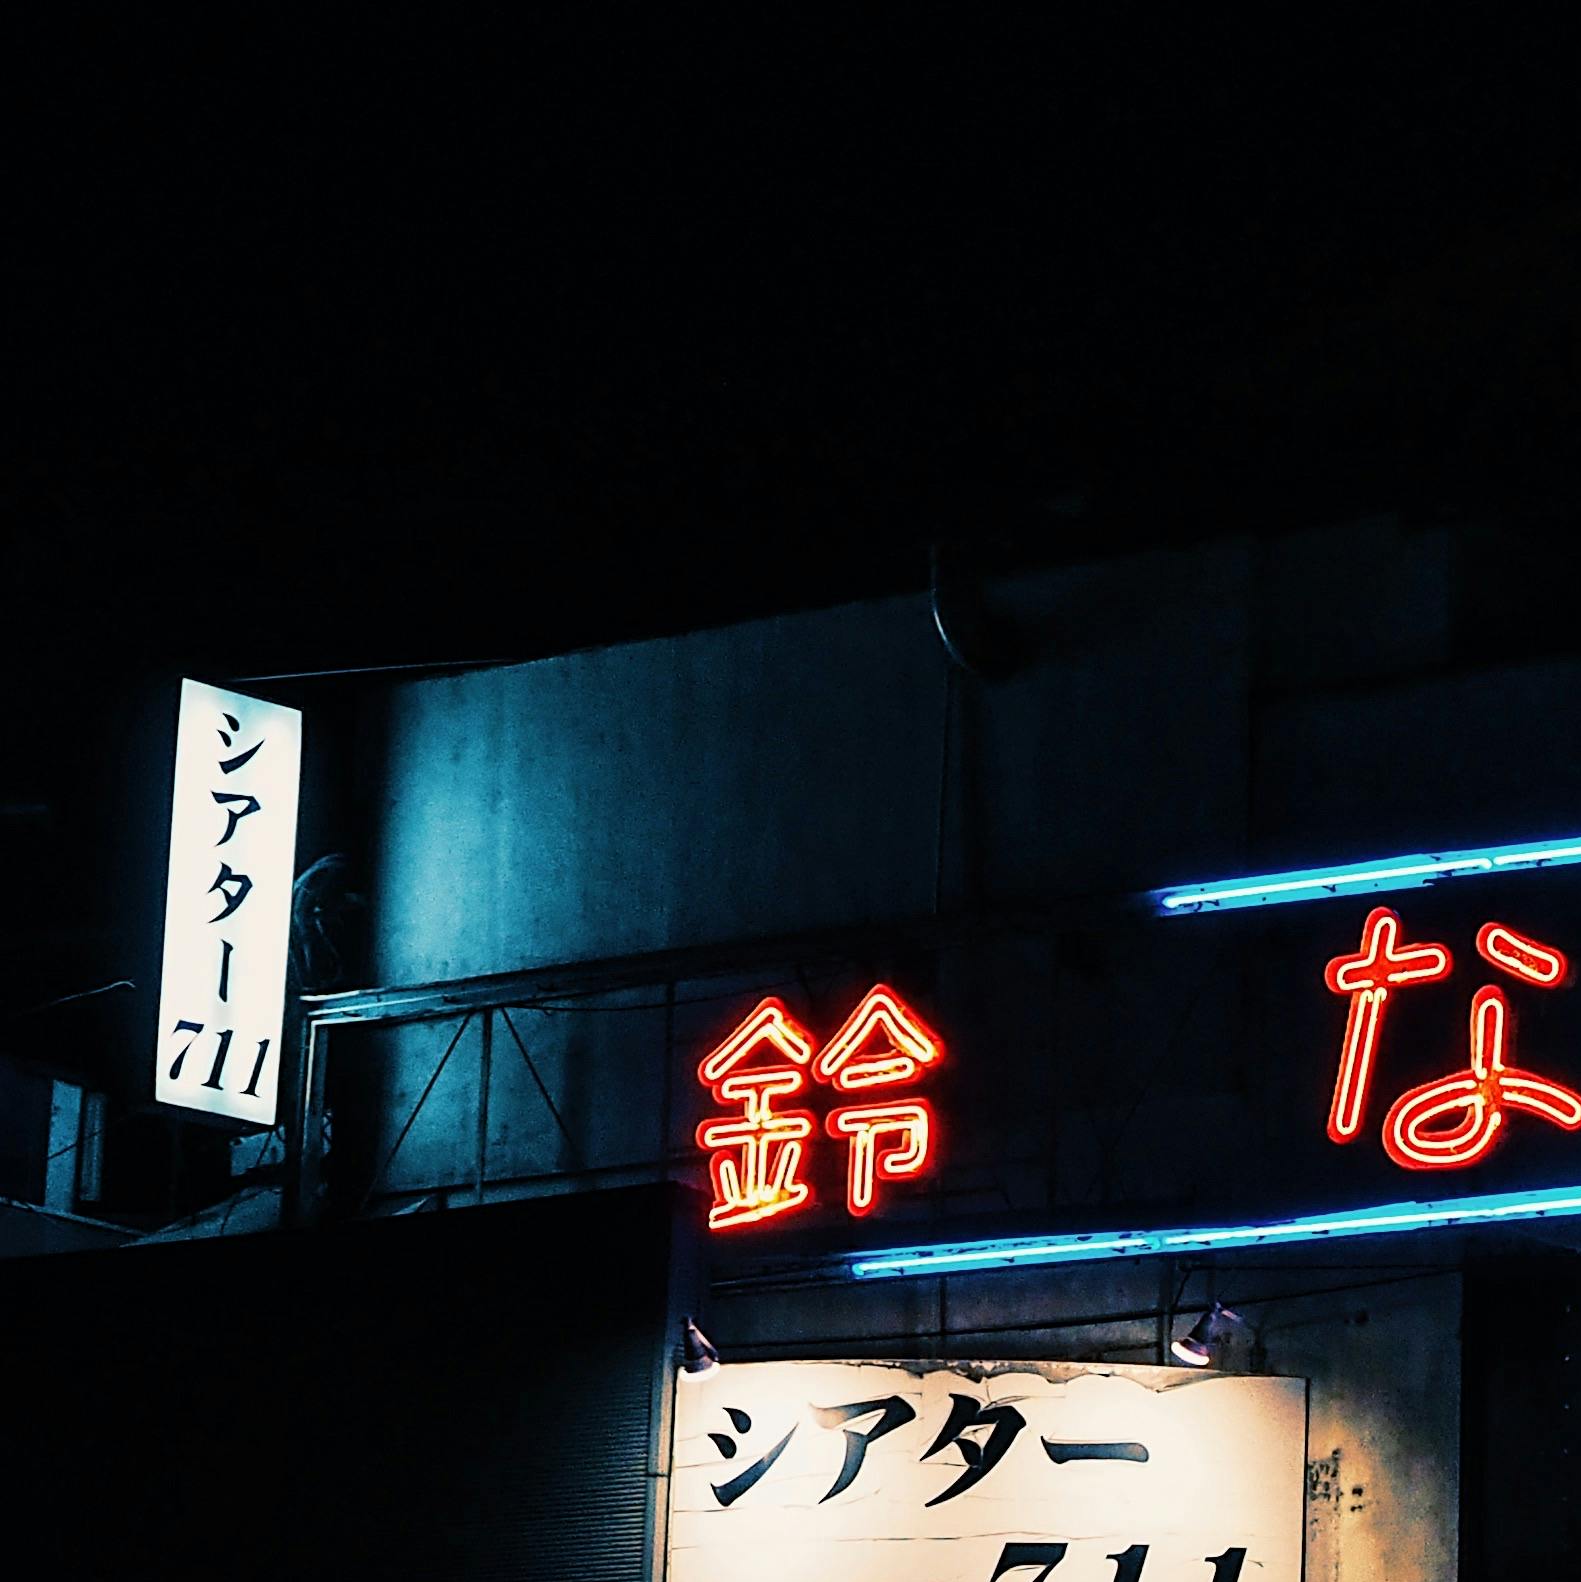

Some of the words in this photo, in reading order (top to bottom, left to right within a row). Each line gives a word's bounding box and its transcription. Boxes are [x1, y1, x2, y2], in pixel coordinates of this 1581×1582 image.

[206, 711, 266, 1003] シアター
[168, 1019, 272, 1098] 711
[708, 1392, 1150, 1508] シアター
